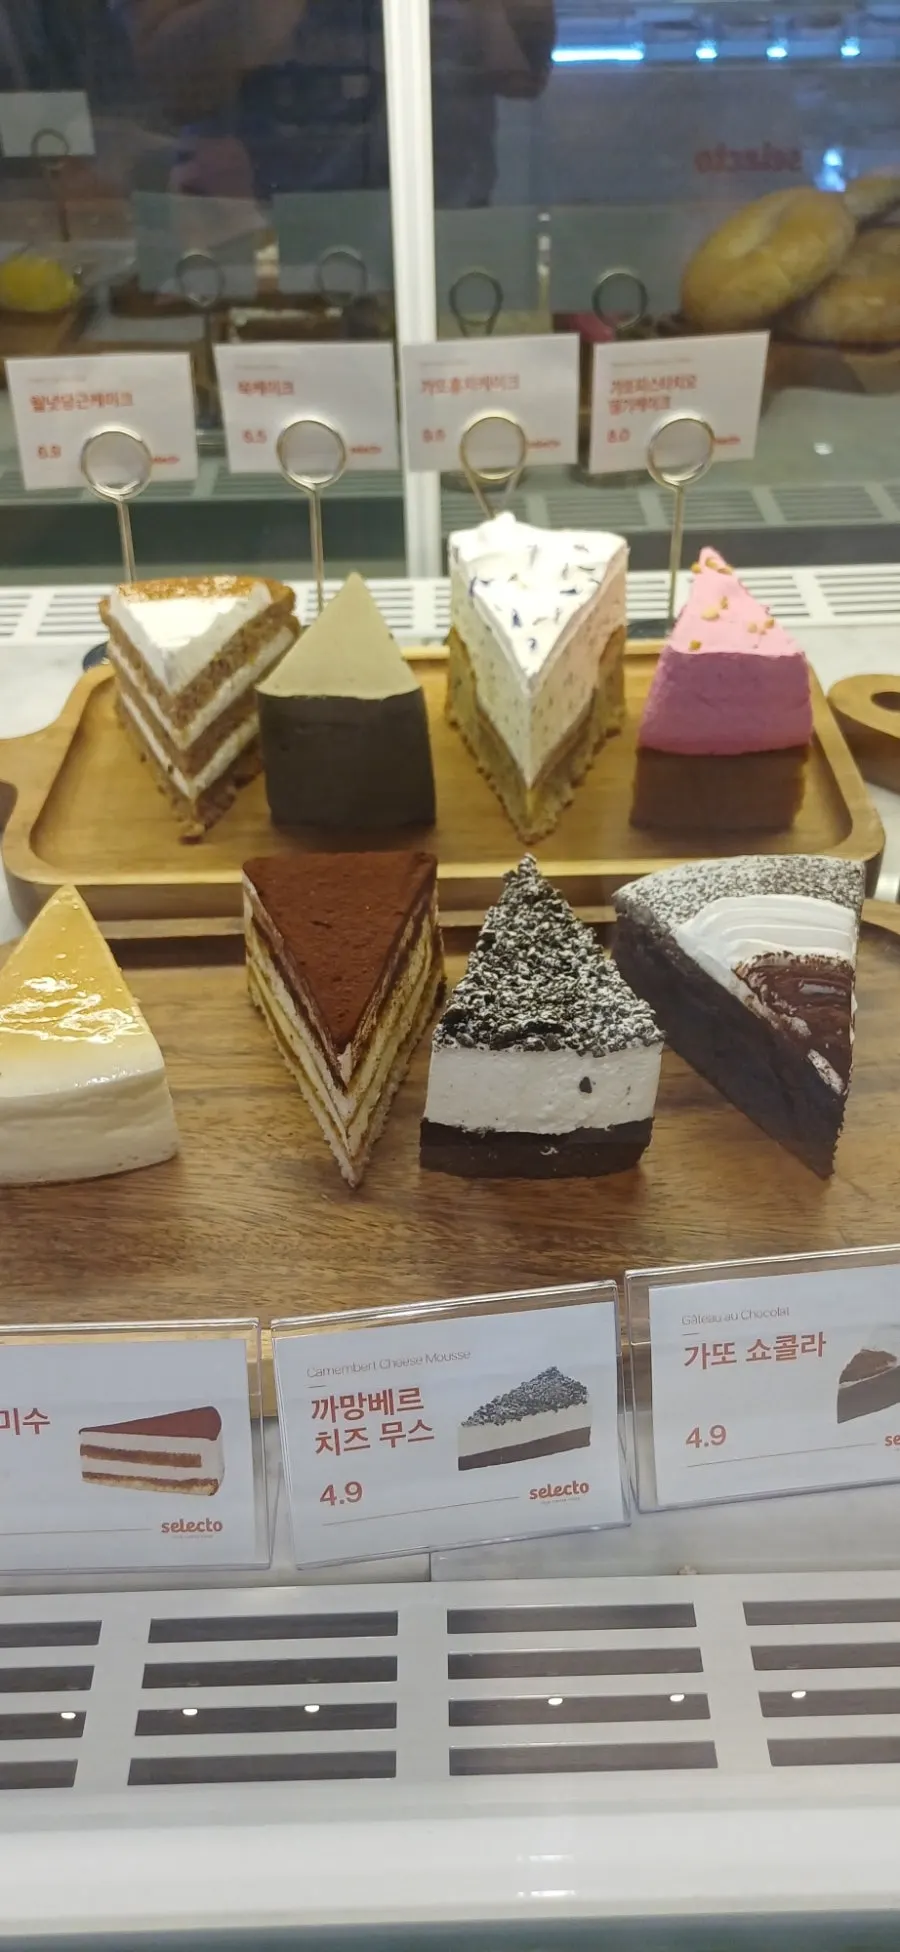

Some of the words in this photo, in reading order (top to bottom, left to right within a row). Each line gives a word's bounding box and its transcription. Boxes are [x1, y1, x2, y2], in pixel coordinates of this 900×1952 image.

[682, 1310, 721, 1326] Gâteau
[724, 1311, 739, 1323] au
[741, 1306, 790, 1321] Chocolat
[684, 1341, 737, 1369] 가또
[745, 1331, 827, 1362] 쇼콜라
[306, 1360, 377, 1378] Camembert
[379, 1357, 423, 1371] Cheese
[425, 1350, 472, 1365] Mousse
[311, 1387, 424, 1423] 까망베르
[0, 1407, 51, 1435] 미수
[315, 1427, 371, 1456] 치즈
[379, 1419, 435, 1448] 무스
[685, 1424, 727, 1448] 4.9
[319, 1481, 363, 1506] 4.9
[529, 1480, 590, 1500] selecto
[161, 1517, 223, 1533] selecto
